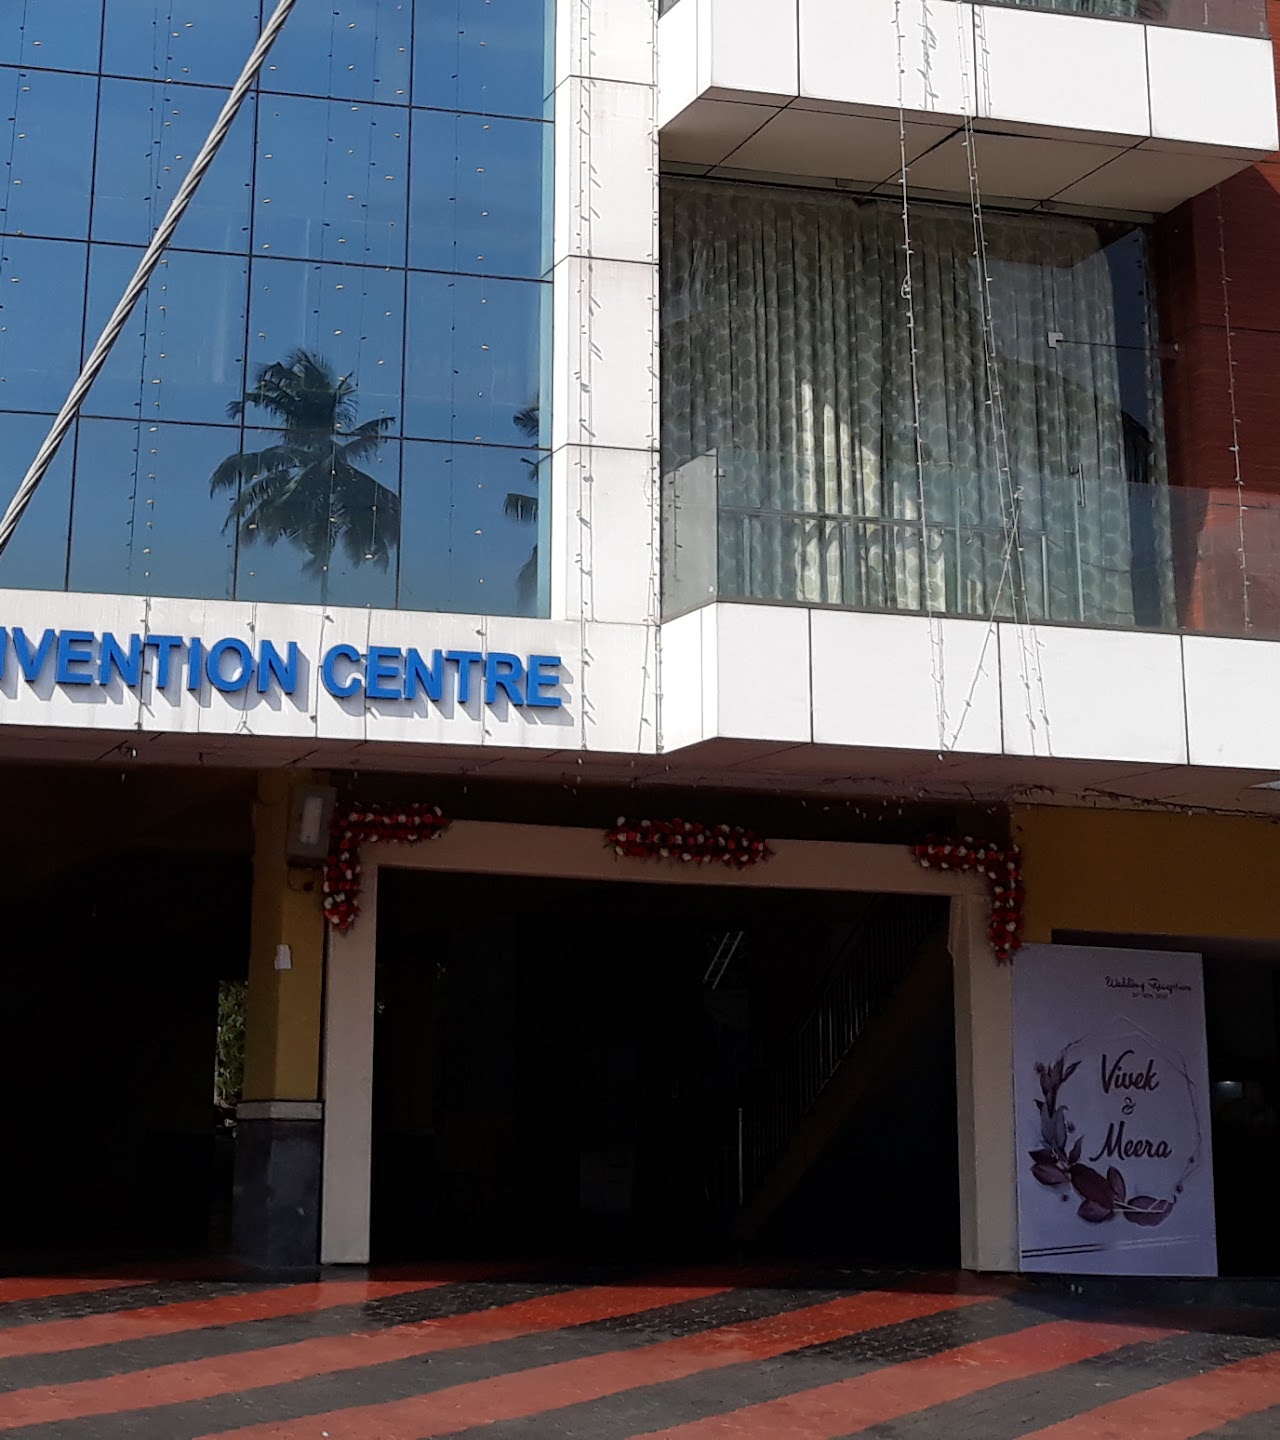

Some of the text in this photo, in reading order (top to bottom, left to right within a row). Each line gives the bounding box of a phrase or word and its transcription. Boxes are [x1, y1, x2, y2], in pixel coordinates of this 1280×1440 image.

[321, 643, 563, 709] CENTRE
[1100, 1049, 1160, 1094] Vivek
[1121, 1097, 1136, 1115] &
[1089, 1122, 1172, 1162] Meera
